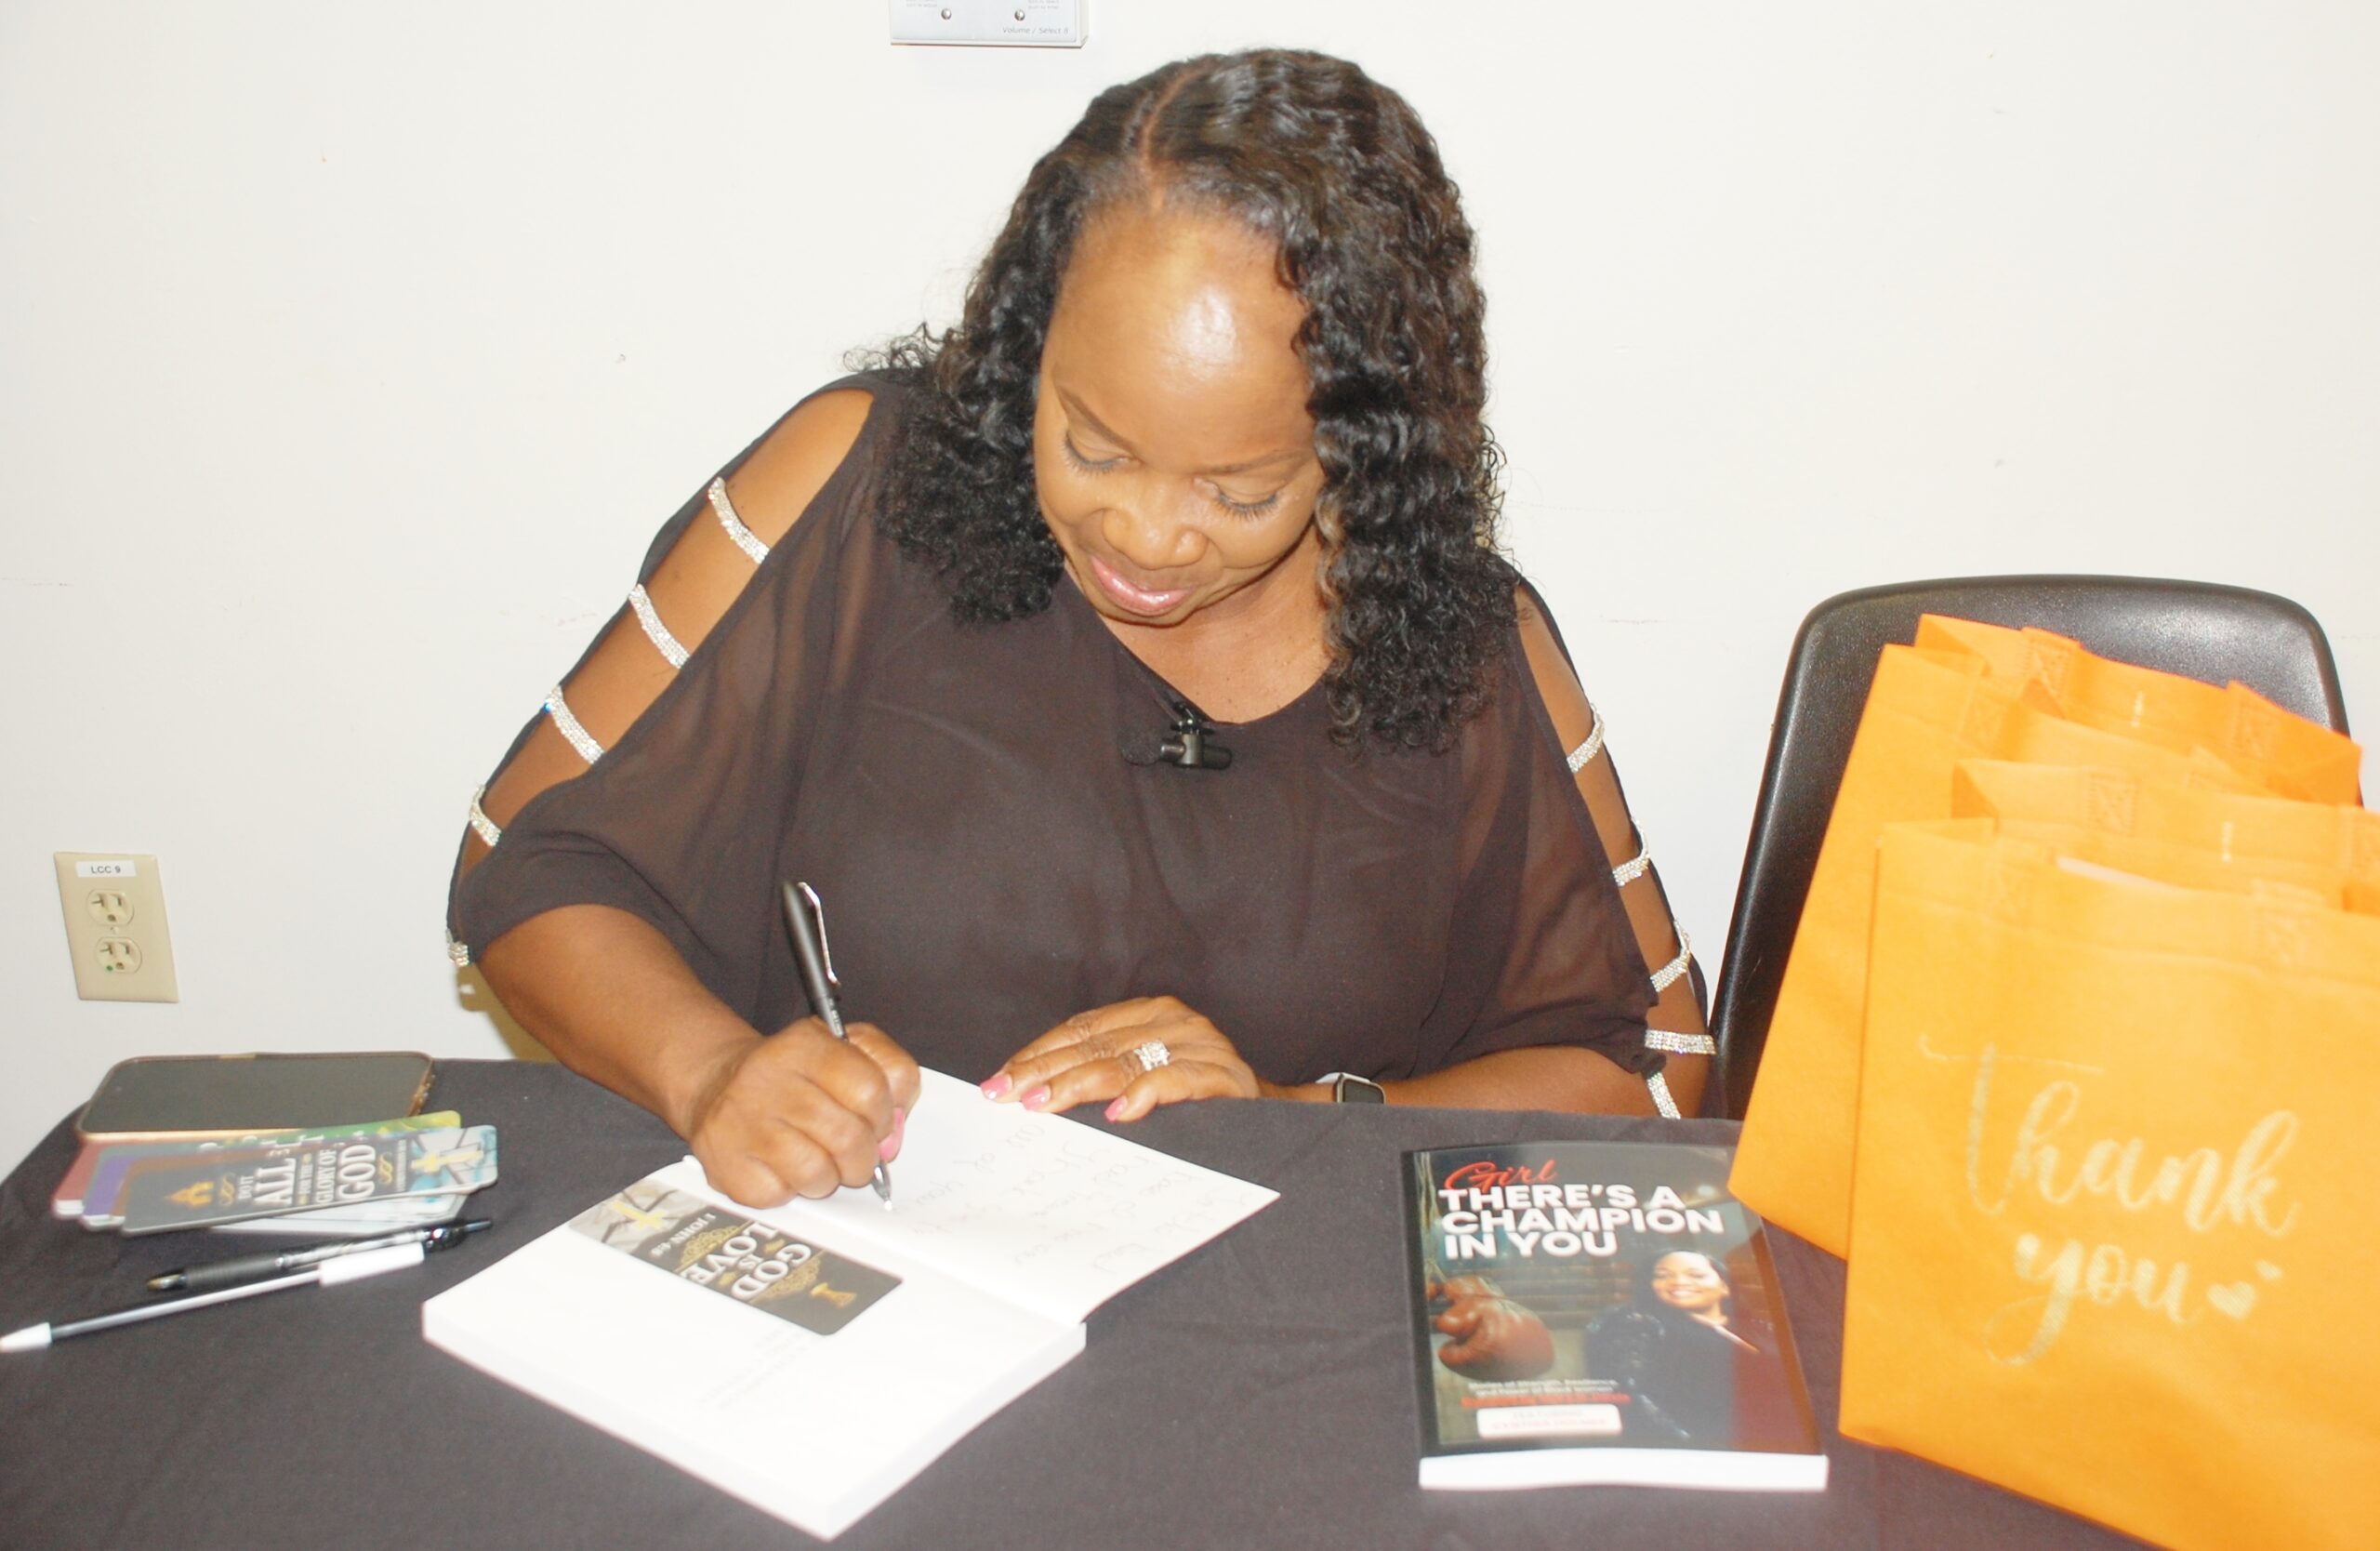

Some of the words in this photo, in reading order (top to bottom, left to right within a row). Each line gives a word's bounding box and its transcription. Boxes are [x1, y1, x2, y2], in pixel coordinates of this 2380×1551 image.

[1002, 26, 1030, 34] Volume
[91, 866, 112, 874] LCC
[1918, 1033, 2301, 1237] Thank
[319, 1149, 337, 1164] OF
[253, 1158, 297, 1204] ALL
[315, 1166, 336, 1203] GLORY
[337, 1145, 376, 1200] GOD
[1445, 1160, 1558, 1194] Girl
[1438, 1184, 1637, 1212] THERE'S
[1649, 1186, 1686, 1210] A
[669, 1217, 708, 1244] JOHN
[1441, 1208, 1725, 1235] CHAMPION
[680, 1221, 778, 1285] LOVE
[1444, 1233, 1497, 1260] IN
[1506, 1231, 1619, 1257] YOU
[732, 1243, 812, 1301] GOD
[737, 1253, 763, 1271] IS
[1983, 1232, 2205, 1367] you
